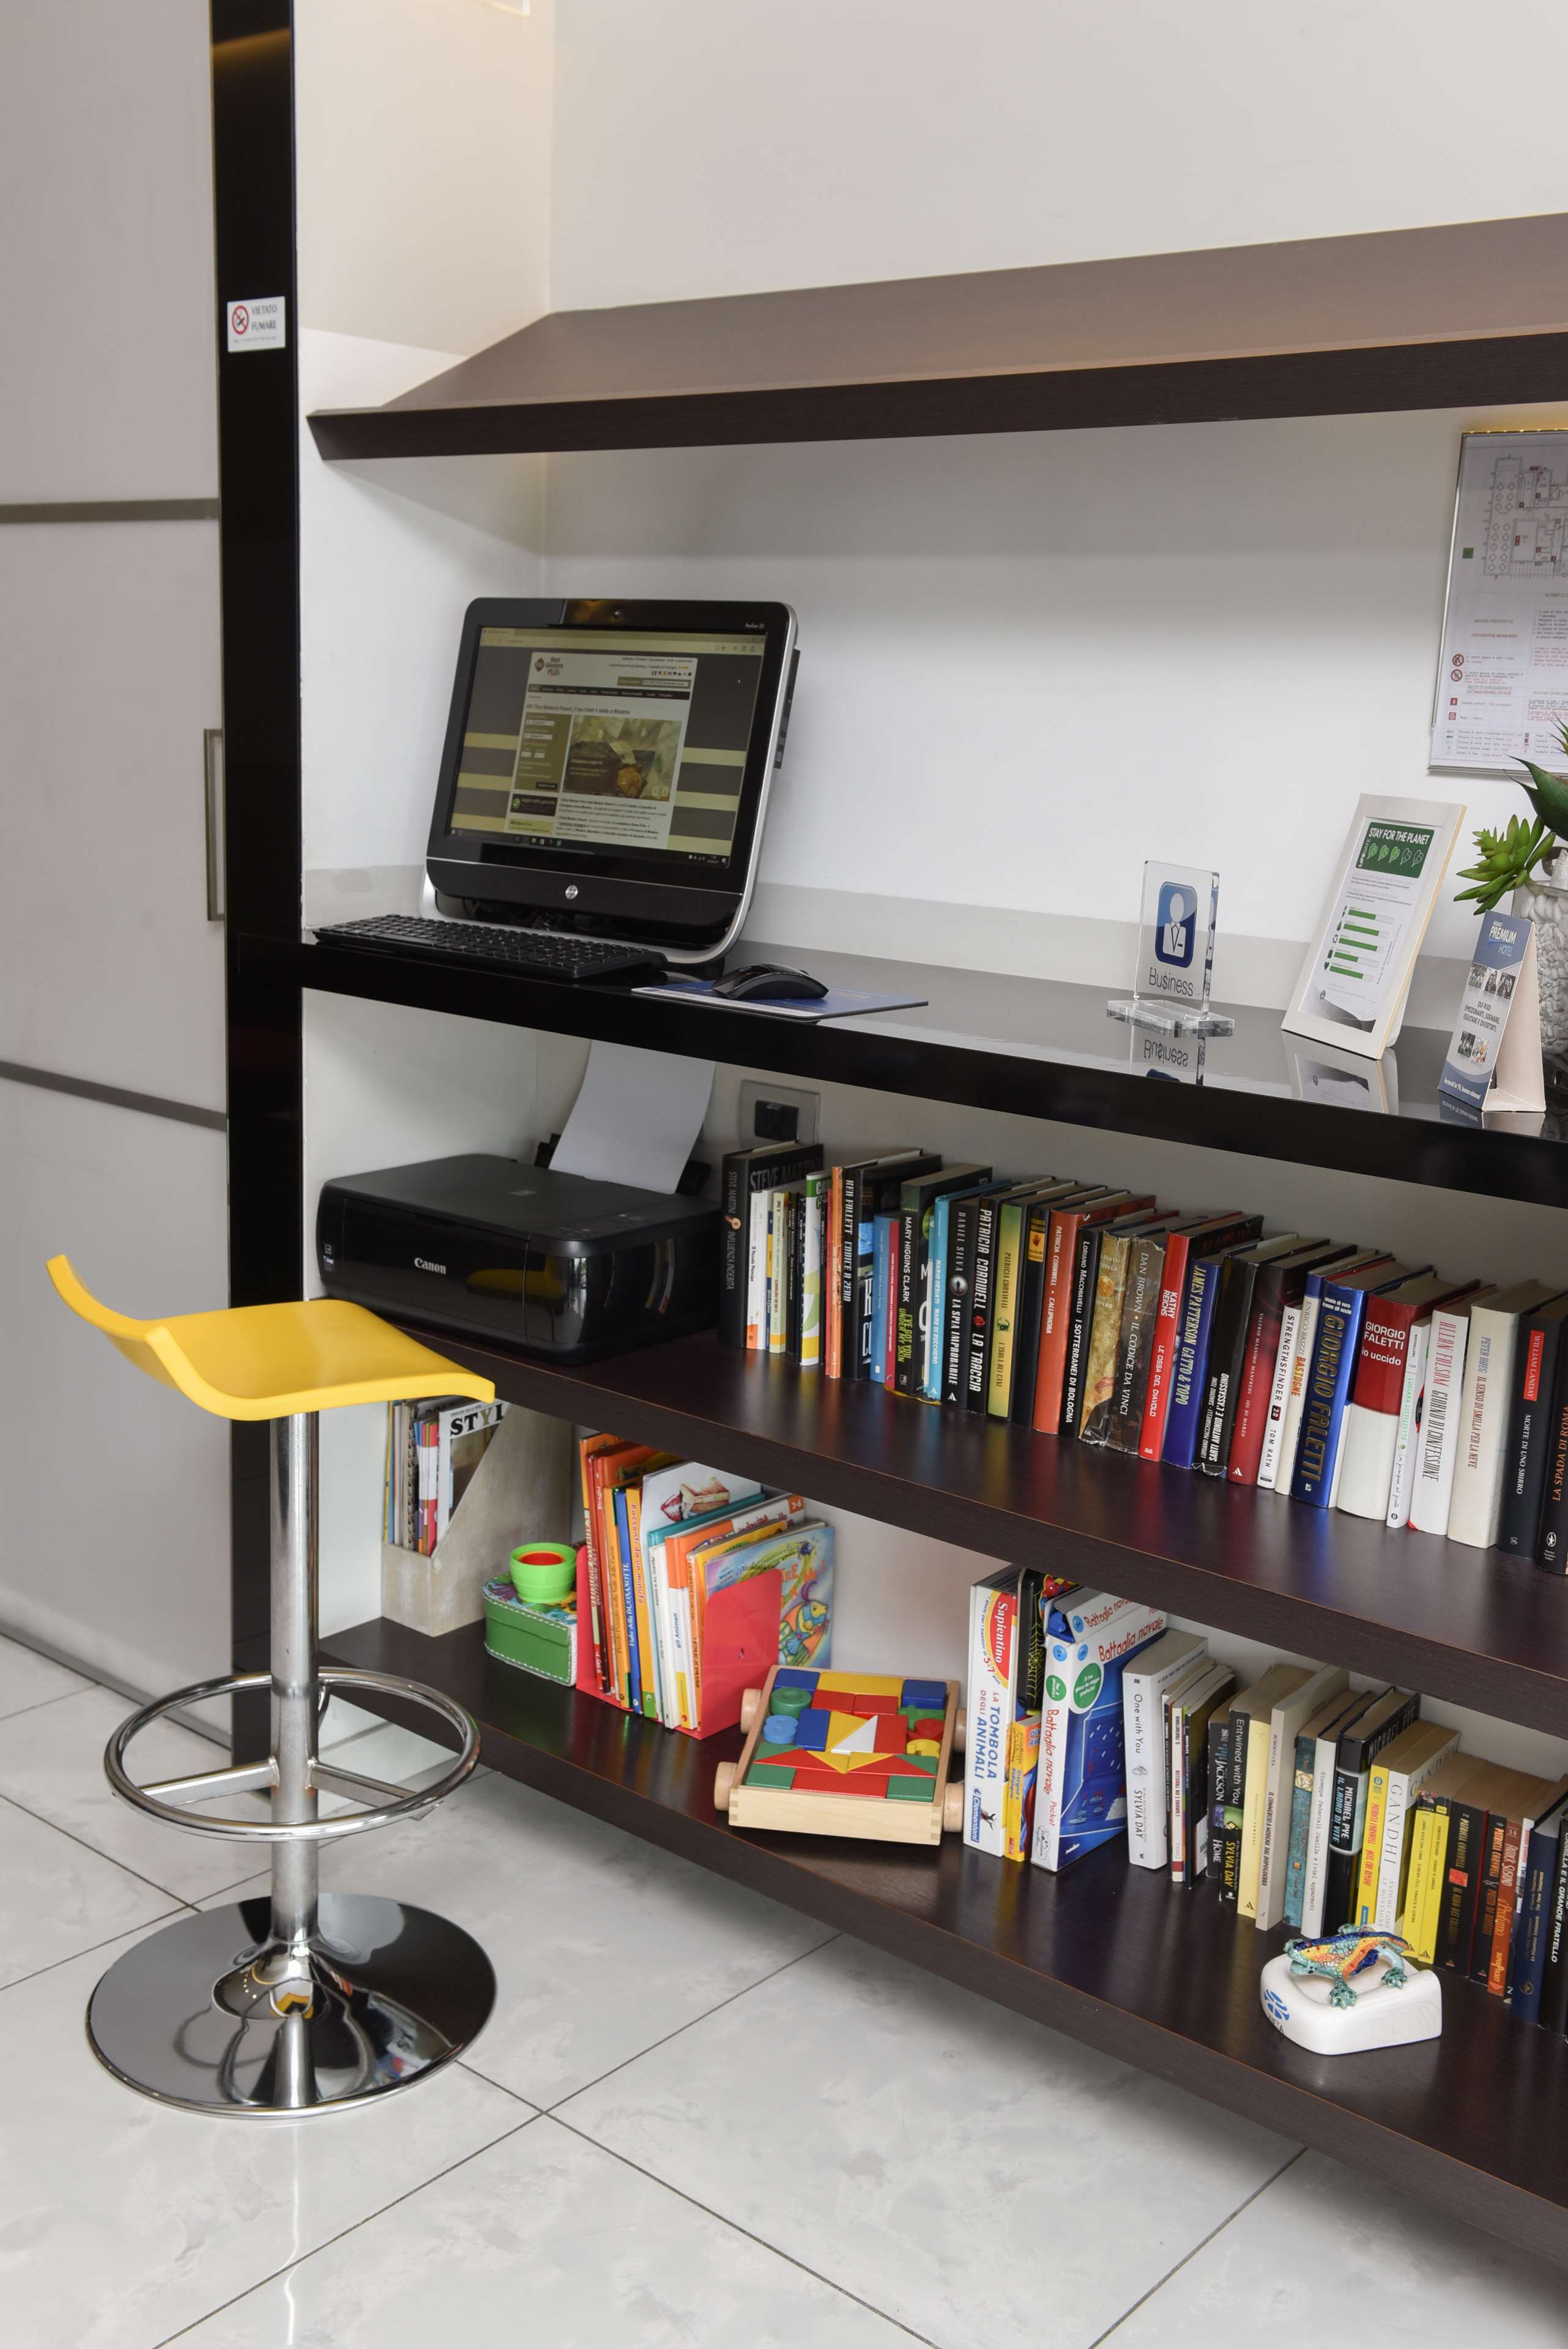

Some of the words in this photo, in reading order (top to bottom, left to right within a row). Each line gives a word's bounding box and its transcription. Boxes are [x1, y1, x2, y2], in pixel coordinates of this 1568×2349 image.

[1369, 828, 1383, 838] STAY
[1383, 830, 1396, 840] FOR
[1395, 831, 1408, 842] THE
[1407, 832, 1430, 845] PLANET
[1489, 926, 1517, 944] PREMIUM
[1498, 944, 1513, 956] HOTEL
[1149, 967, 1194, 997] Business
[729, 1171, 737, 1189] STEVE
[845, 1180, 854, 1197] KEN
[844, 1199, 853, 1235] FOLLETT
[957, 1212, 967, 1242] DANIEL
[978, 1208, 992, 1254] PATRICIA
[414, 1257, 446, 1275] Canon
[844, 1242, 852, 1270] CODICE
[955, 1246, 965, 1271] SILVA
[1080, 1241, 1090, 1268] LORIANO
[1139, 1253, 1149, 1275] DAN
[974, 1258, 989, 1309] CORNWELL
[1050, 1255, 1059, 1286] CORNWELL
[1191, 1265, 1207, 1295] JAMES
[952, 1298, 961, 1308] LA
[1076, 1270, 1087, 1314] MACCHIAVELLI
[1134, 1276, 1146, 1314] BROWN
[1161, 1289, 1170, 1317] REICHS
[1167, 1292, 1178, 1319] KATHY
[951, 1311, 961, 1329] SPIA
[1046, 1297, 1055, 1334] CALLIPHORA
[1132, 1322, 1139, 1332] IL
[1183, 1294, 1203, 1346] PATTERSON
[1303, 1301, 1312, 1331] ENRICO
[972, 1333, 984, 1346] LA
[1297, 1331, 1307, 1355] BRIZZI
[1364, 1331, 1404, 1350] FALETTI
[1365, 1321, 1406, 1341] GIORGIO
[1436, 1320, 1457, 1352] ALLAN
[949, 1331, 960, 1385] IMPROBABILE
[1069, 1324, 1082, 1376] SOTTERRANEI
[1126, 1334, 1138, 1371] CODICE
[1158, 1345, 1165, 1354] LE
[1274, 1315, 1295, 1401] STRENGTHSFINDER
[1313, 1314, 1345, 1398] GIORGIO
[1361, 1346, 1369, 1357] io
[1370, 1352, 1402, 1366] uccido
[1479, 1336, 1491, 1357] PETER
[1530, 1335, 1541, 1368] WILLIAM
[969, 1351, 983, 1392] TRACCIA
[1179, 1347, 1195, 1376] GATTO
[1433, 1352, 1453, 1387] FOLSOM
[1069, 1377, 1076, 1387] DI
[1124, 1371, 1132, 1386] DA
[1291, 1356, 1306, 1398] BASTOGNE
[1527, 1368, 1537, 1399] LANDAY
[1065, 1387, 1076, 1423] BOLOGNA
[1120, 1388, 1131, 1416] VINCI
[1150, 1388, 1159, 1418] DIAVOLO
[1175, 1383, 1191, 1405] TOPO
[1217, 1373, 1230, 1411] L'ASSASSINO
[1429, 1390, 1449, 1420] GIORNO
[1475, 1382, 1486, 1402] SENSO
[1211, 1416, 1223, 1442] ANTONIO
[1402, 1404, 1410, 1440] LITTIZZETTO
[1429, 1420, 1446, 1431] DI
[1471, 1409, 1483, 1432] SMILLA
[1522, 1414, 1531, 1440] MORTE
[1301, 1400, 1331, 1482] FALETTI
[1470, 1432, 1481, 1444] PER
[1522, 1440, 1529, 1450] DI
[1558, 1439, 1567, 1451] DI
[1209, 1442, 1219, 1462] SARTI
[1265, 1448, 1273, 1468] RATH
[1422, 1430, 1444, 1482] CONFESSIONE
[1468, 1453, 1479, 1469] NEVE
[1519, 1450, 1528, 1468] UNO
[1516, 1468, 1526, 1494] SBIRRO
[1554, 1453, 1566, 1486] SPADA
[1552, 1488, 1561, 1502] LA
[631, 1504, 639, 1544] Racconti
[634, 1546, 641, 1558] da
[636, 1560, 642, 1571] un
[1083, 1606, 1113, 1628] Battaglia
[1113, 1598, 1132, 1612] nava
[995, 1601, 1008, 1664] Sapientino
[1098, 1631, 1136, 1662] Battaglia
[1138, 1616, 1164, 1640] navale
[984, 1657, 995, 1673] 5-7
[994, 1692, 999, 1702] LA
[1134, 1694, 1143, 1714] One
[987, 1706, 1000, 1779] TOMBOLA
[1042, 1709, 1060, 1757] Battaglia
[1135, 1737, 1143, 1754] You
[1233, 1718, 1245, 1763] Entwined
[975, 1717, 987, 1779] ANIMALI
[1043, 1759, 1056, 1795] navale
[1214, 1760, 1226, 1801] JACKSON
[1233, 1765, 1243, 1785] with
[1134, 1790, 1143, 1822] SYLVIA
[1232, 1787, 1241, 1804] You
[1335, 1786, 1344, 1816] LADRO
[1342, 1786, 1353, 1823] MICHAEL
[972, 1796, 981, 1842] Clementoni
[1047, 1801, 1057, 1826] Pocket
[1334, 1815, 1342, 1825] DI
[1384, 1784, 1403, 1865] GANDHI
[1135, 1823, 1143, 1843] DAY
[1332, 1825, 1340, 1844] VITE
[1340, 1823, 1350, 1840] PYE
[1458, 1818, 1469, 1842] PATRICIA
[1492, 1827, 1504, 1851] PATRICIA
[1213, 1839, 1223, 1863] HOME
[1225, 1841, 1235, 1871] SYLVIA
[1455, 1842, 1467, 1868] CORNWELL
[1489, 1852, 1501, 1877] CORNWELL
[1504, 1843, 1518, 1863] PATRICK
[1224, 1872, 1233, 1888] DAY
[1556, 1886, 1566, 1921] GRANDE
[1495, 1902, 1512, 1936] Profumo
[1551, 1921, 1562, 1963] FRATELLO
